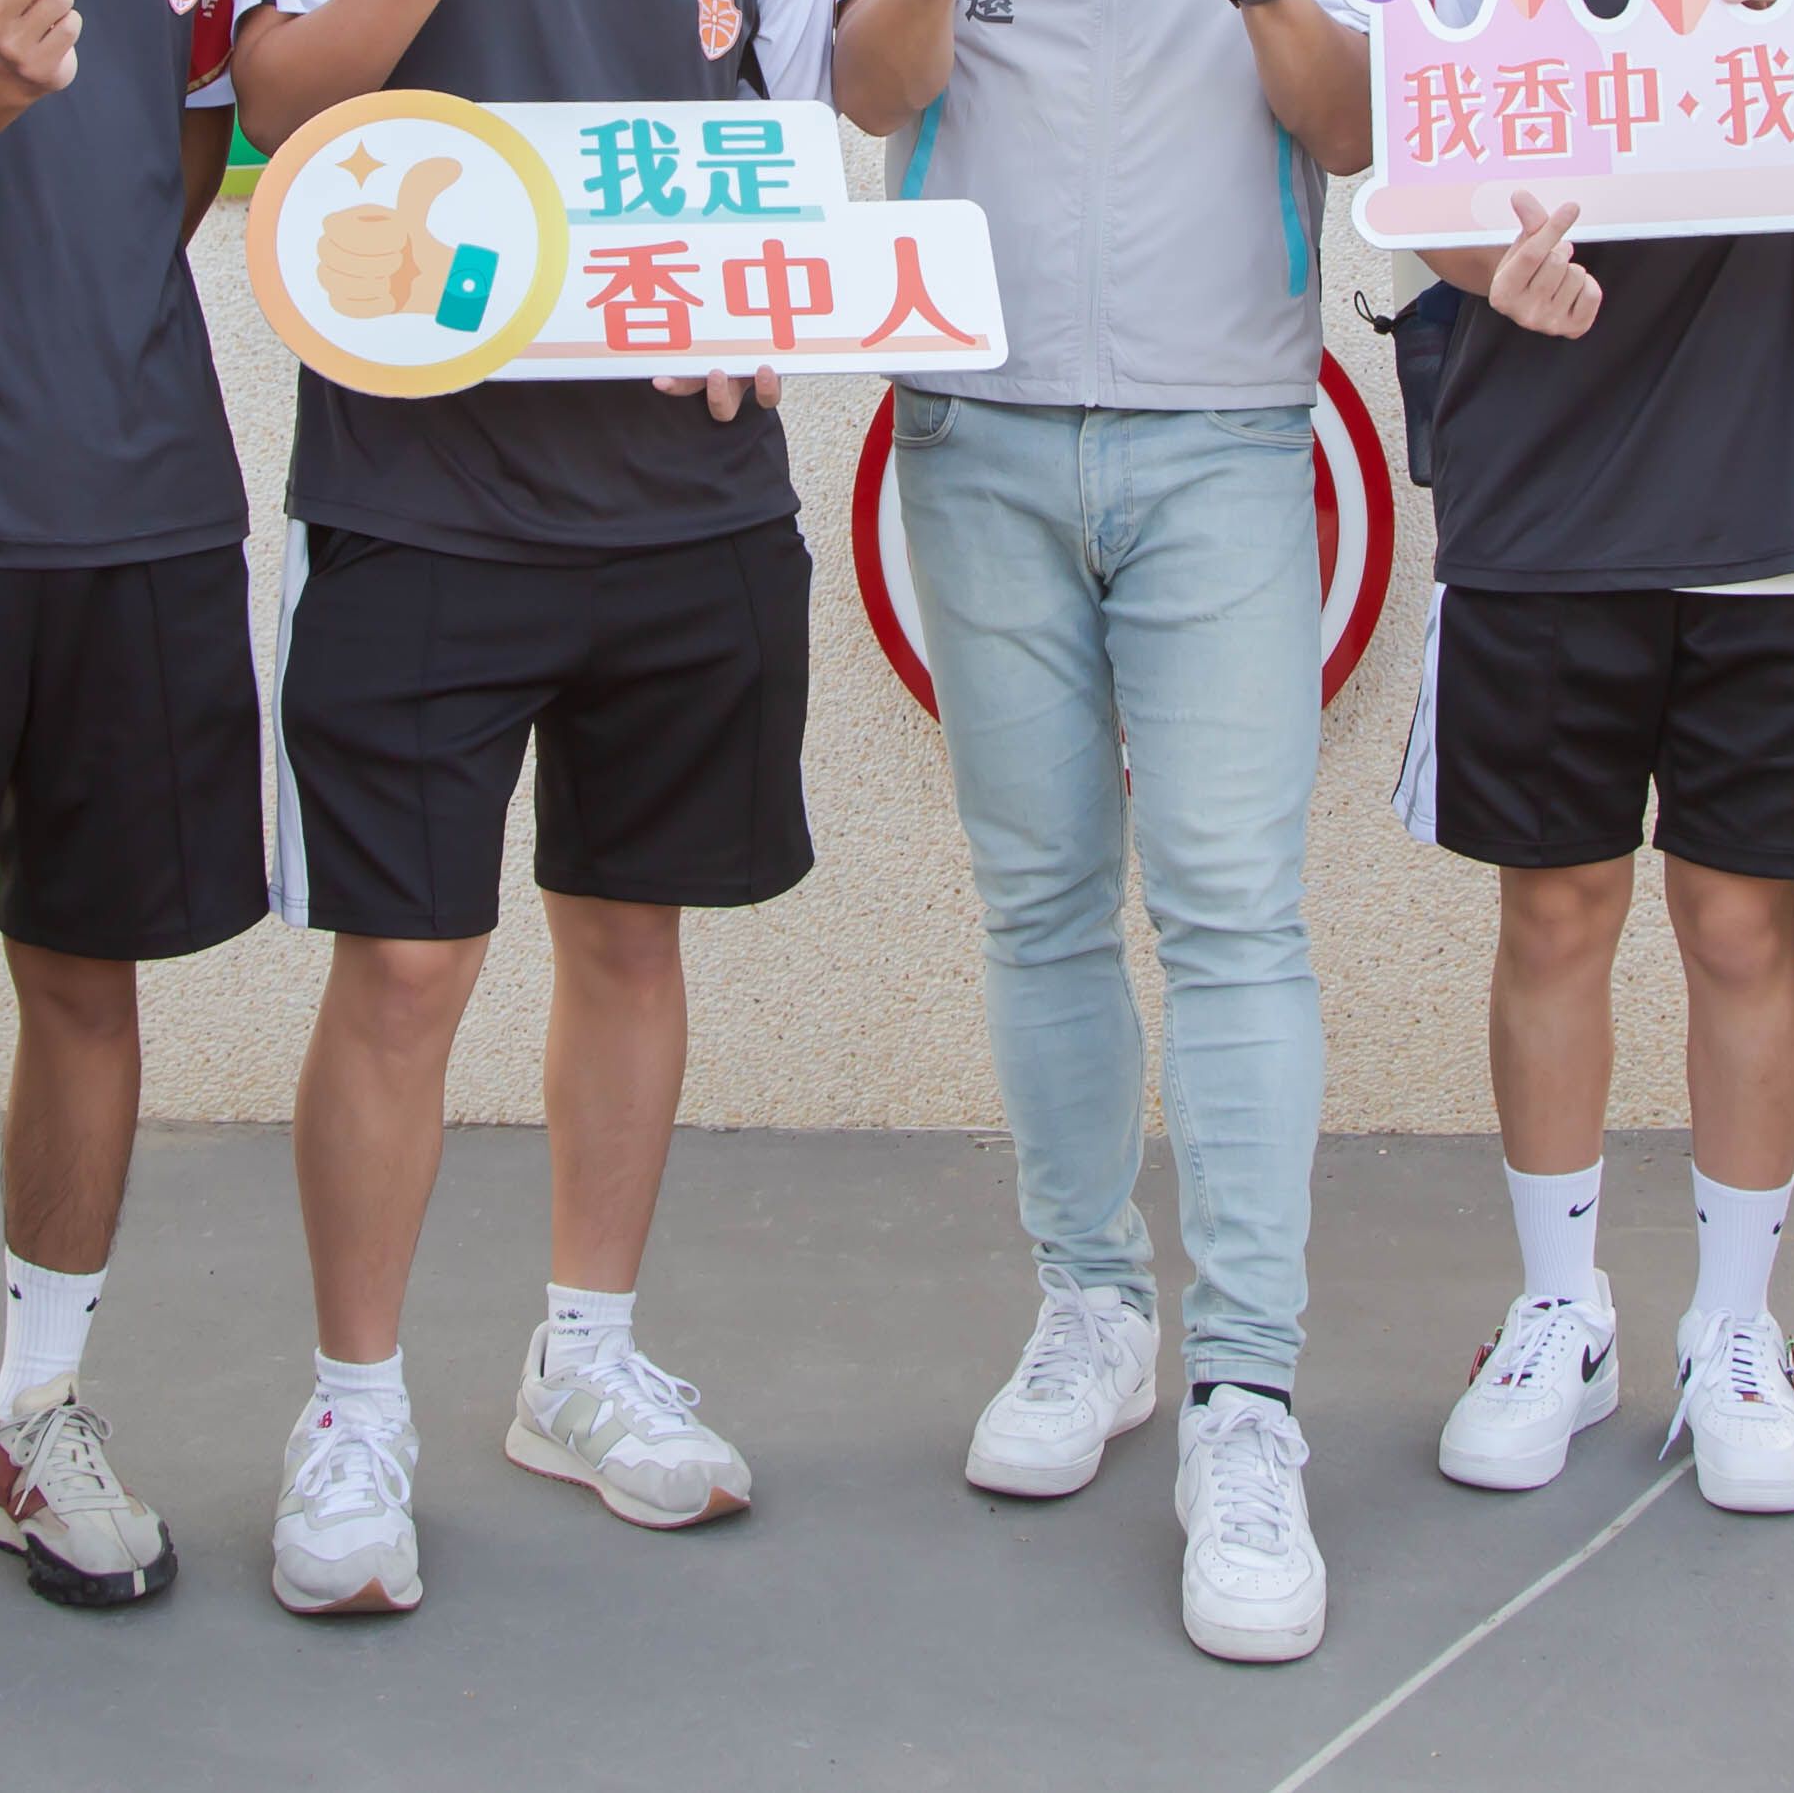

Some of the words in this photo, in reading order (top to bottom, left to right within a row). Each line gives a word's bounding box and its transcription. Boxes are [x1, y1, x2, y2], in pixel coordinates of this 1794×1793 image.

[578, 117, 802, 218] 我是
[582, 235, 978, 352] 香中人
